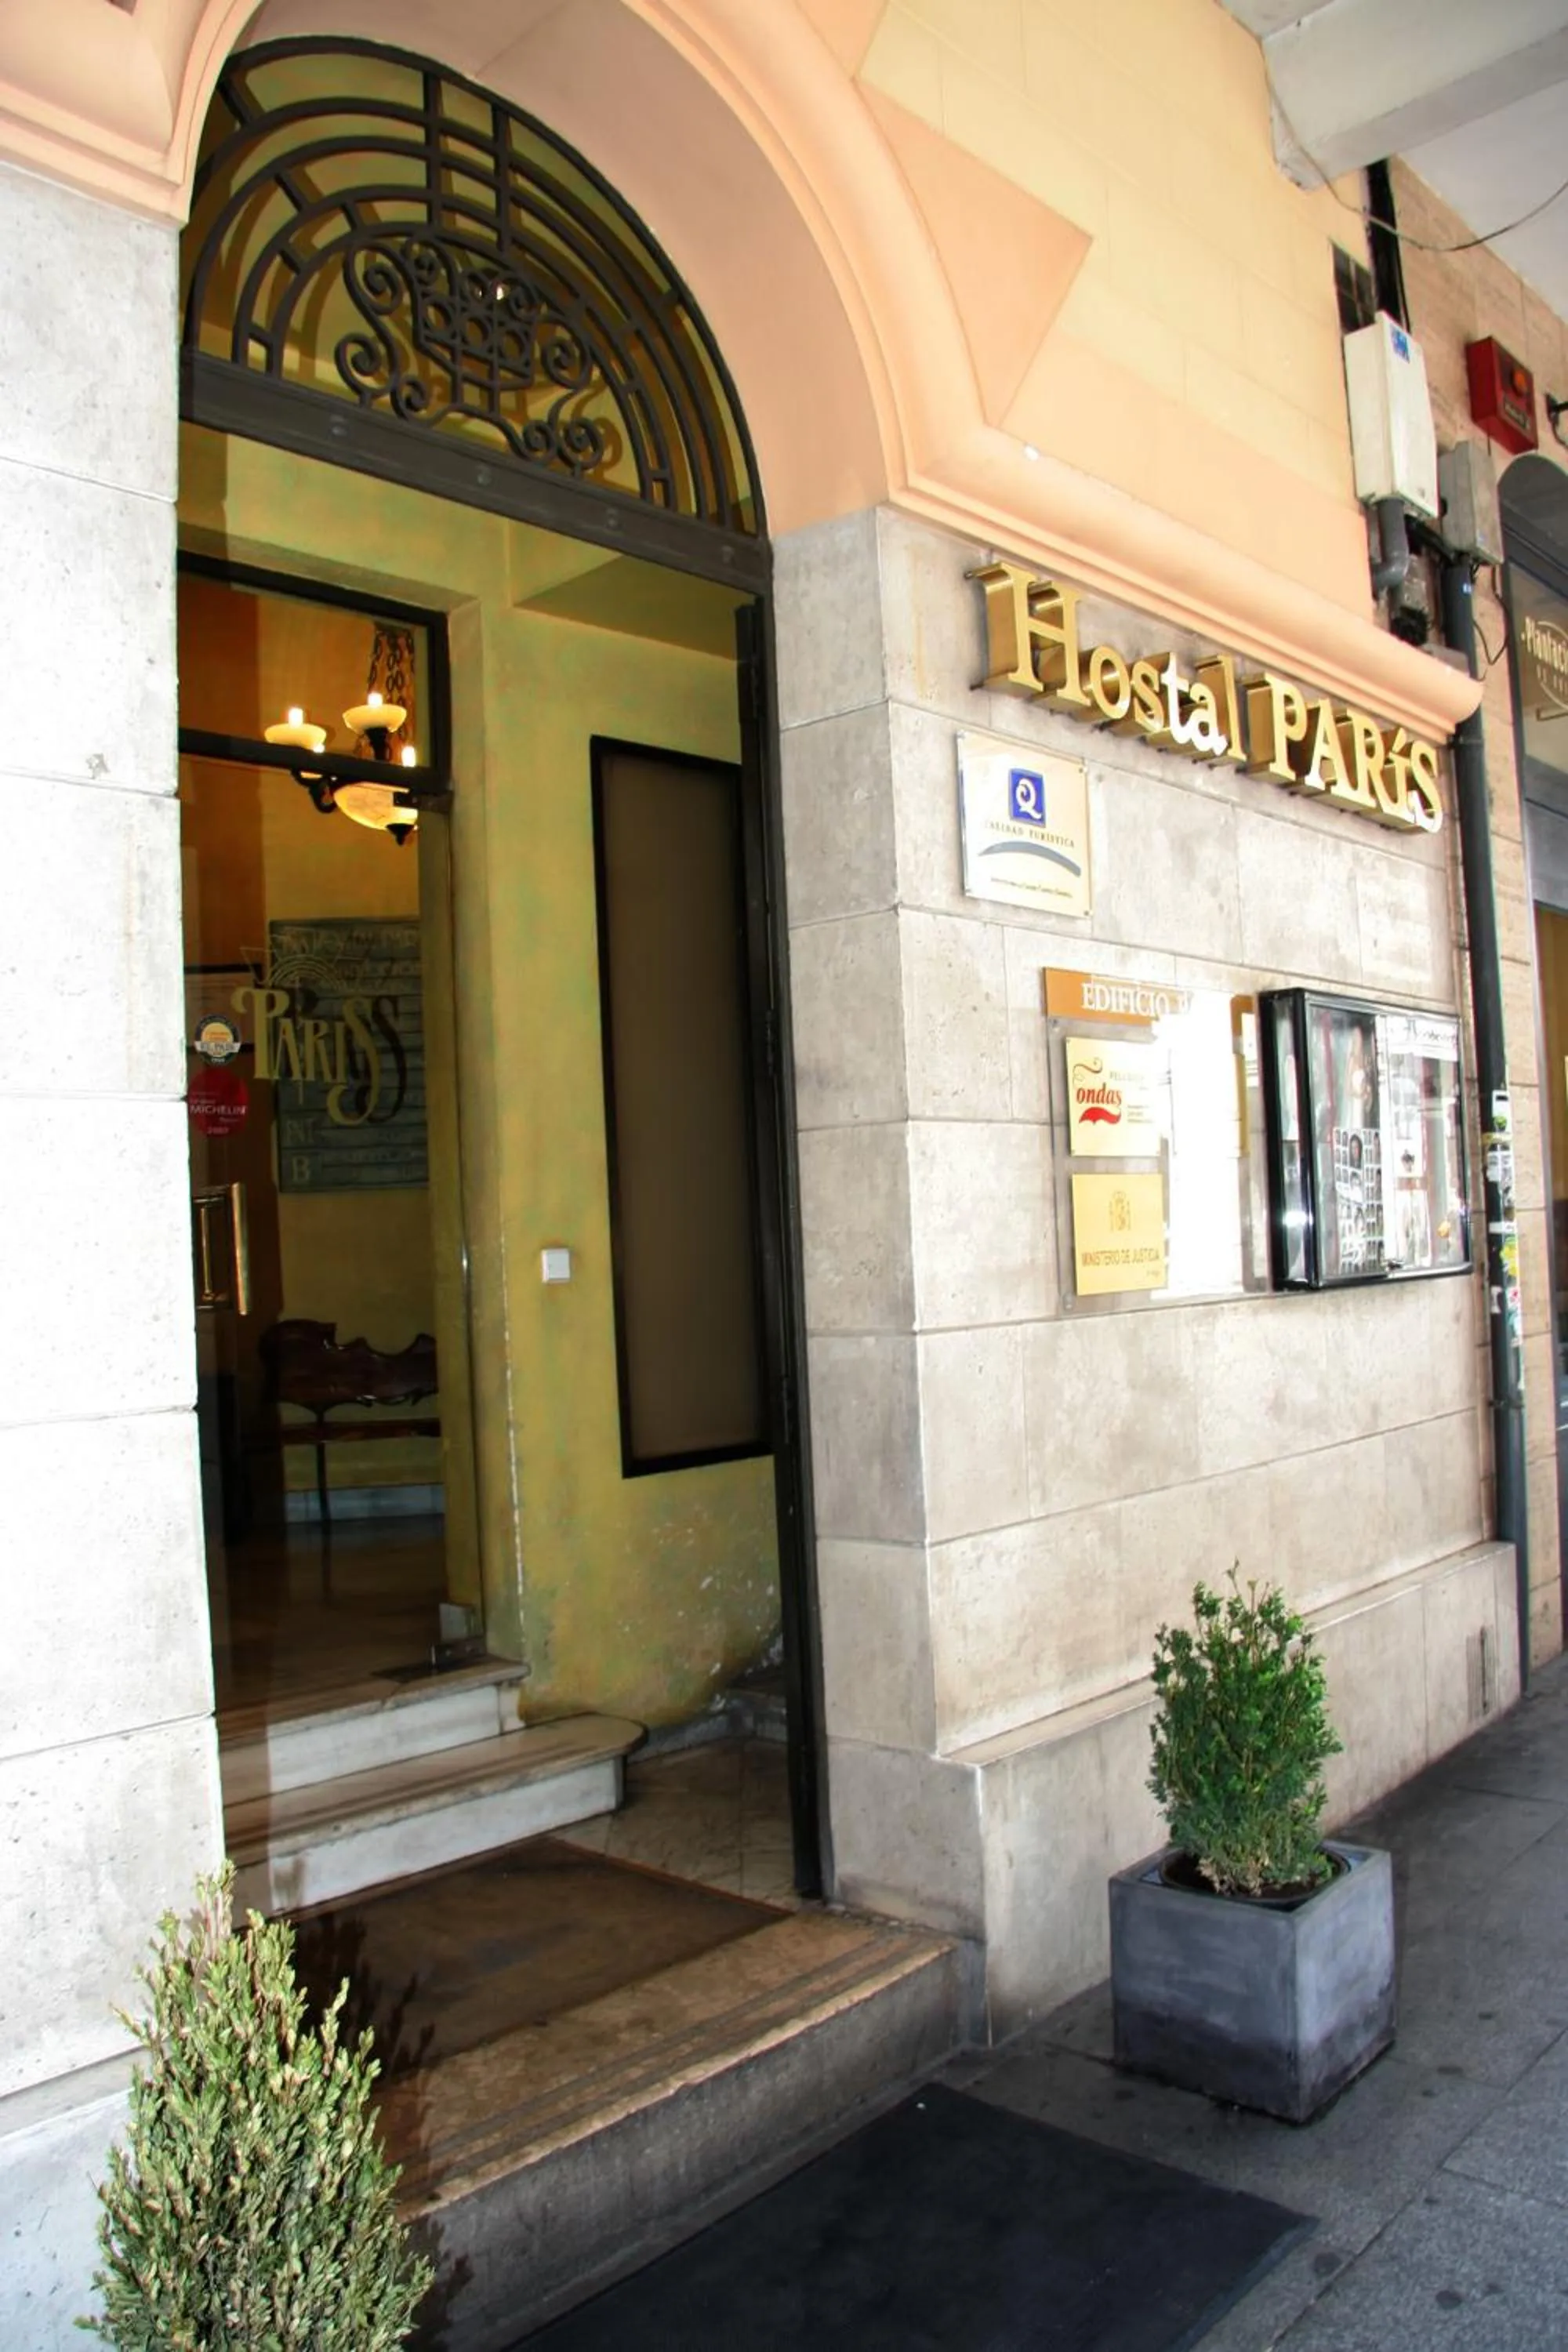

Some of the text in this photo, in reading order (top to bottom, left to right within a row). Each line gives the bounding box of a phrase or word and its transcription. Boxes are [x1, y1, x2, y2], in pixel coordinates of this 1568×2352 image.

[994, 561, 1247, 761] Hostal
[1080, 982, 1171, 1018] EDIFICIO
[1076, 1082, 1123, 1107] ondas
[190, 1105, 246, 1116] MICHELIN
